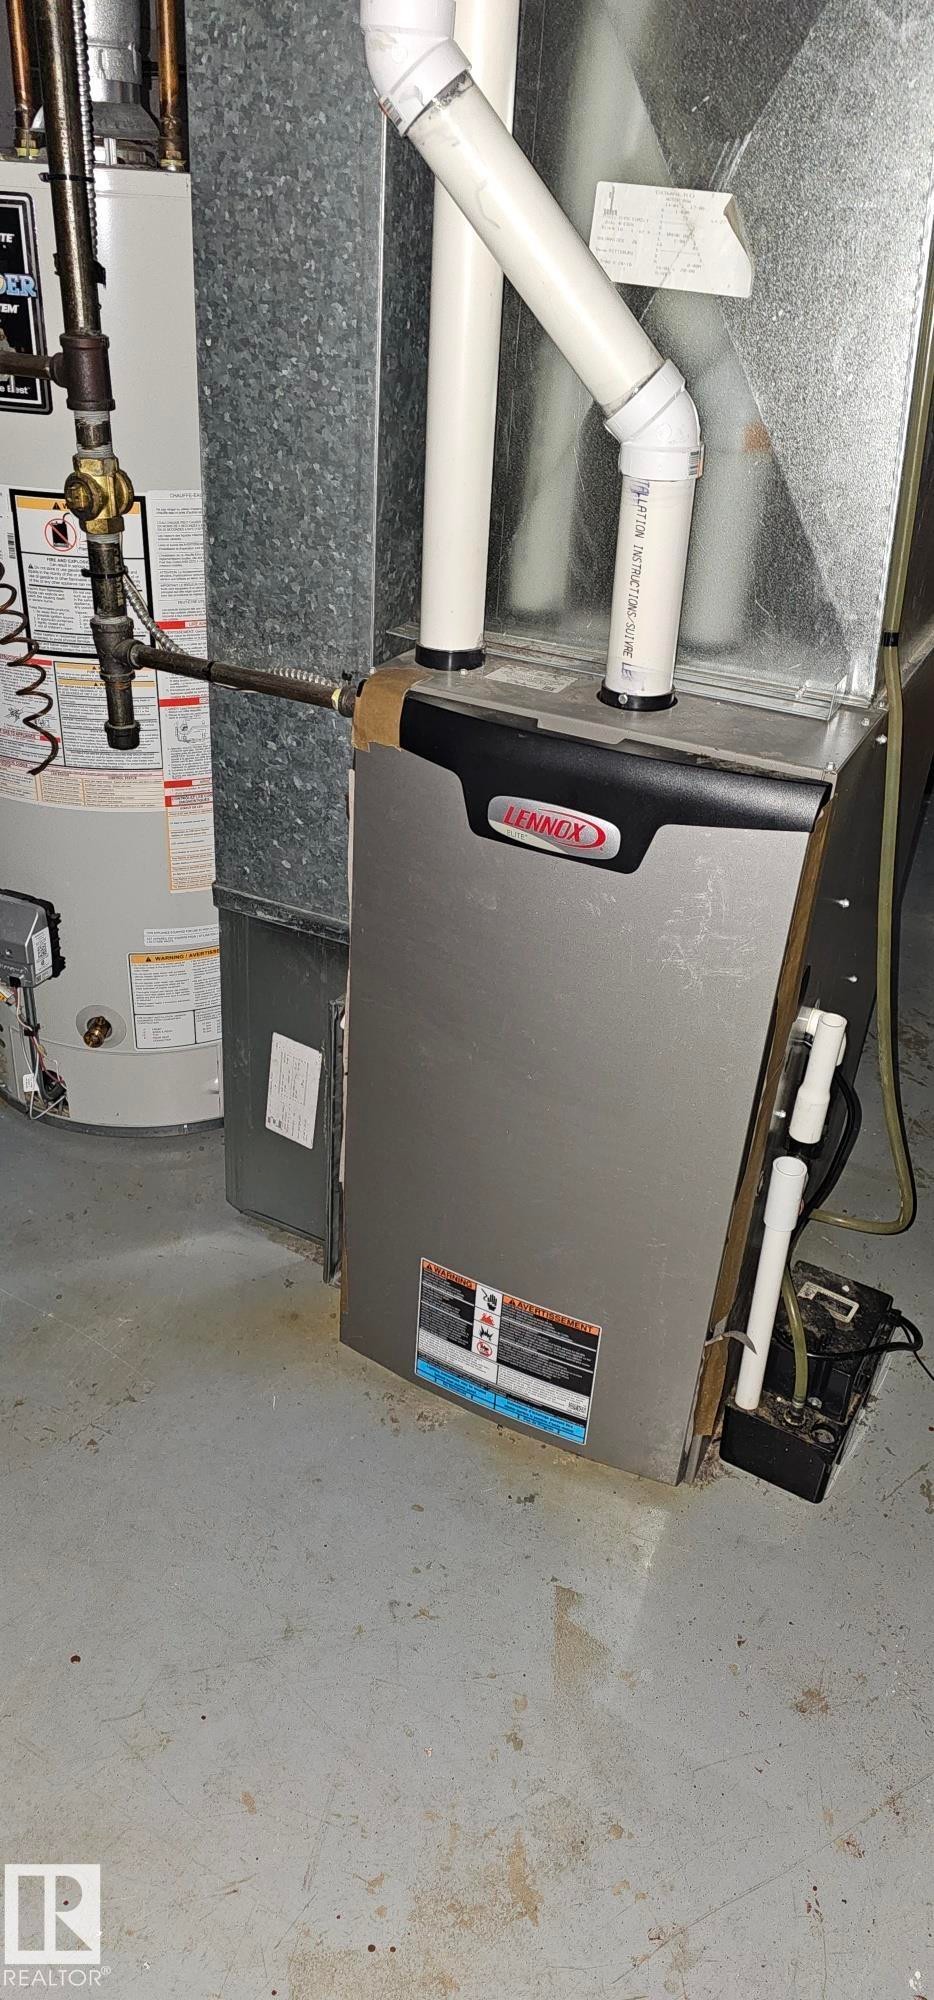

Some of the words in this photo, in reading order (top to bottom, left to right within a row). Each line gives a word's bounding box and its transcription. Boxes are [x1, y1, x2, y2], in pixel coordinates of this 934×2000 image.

[0, 303, 18, 314] EM
[623, 544, 643, 659] INSTRUCTIONS/SUIVRE
[503, 806, 587, 843] LENNOX
[154, 953, 185, 962] WARNING
[434, 1265, 472, 1289] WARNING
[518, 1302, 592, 1333] AVERTISSEMENT
